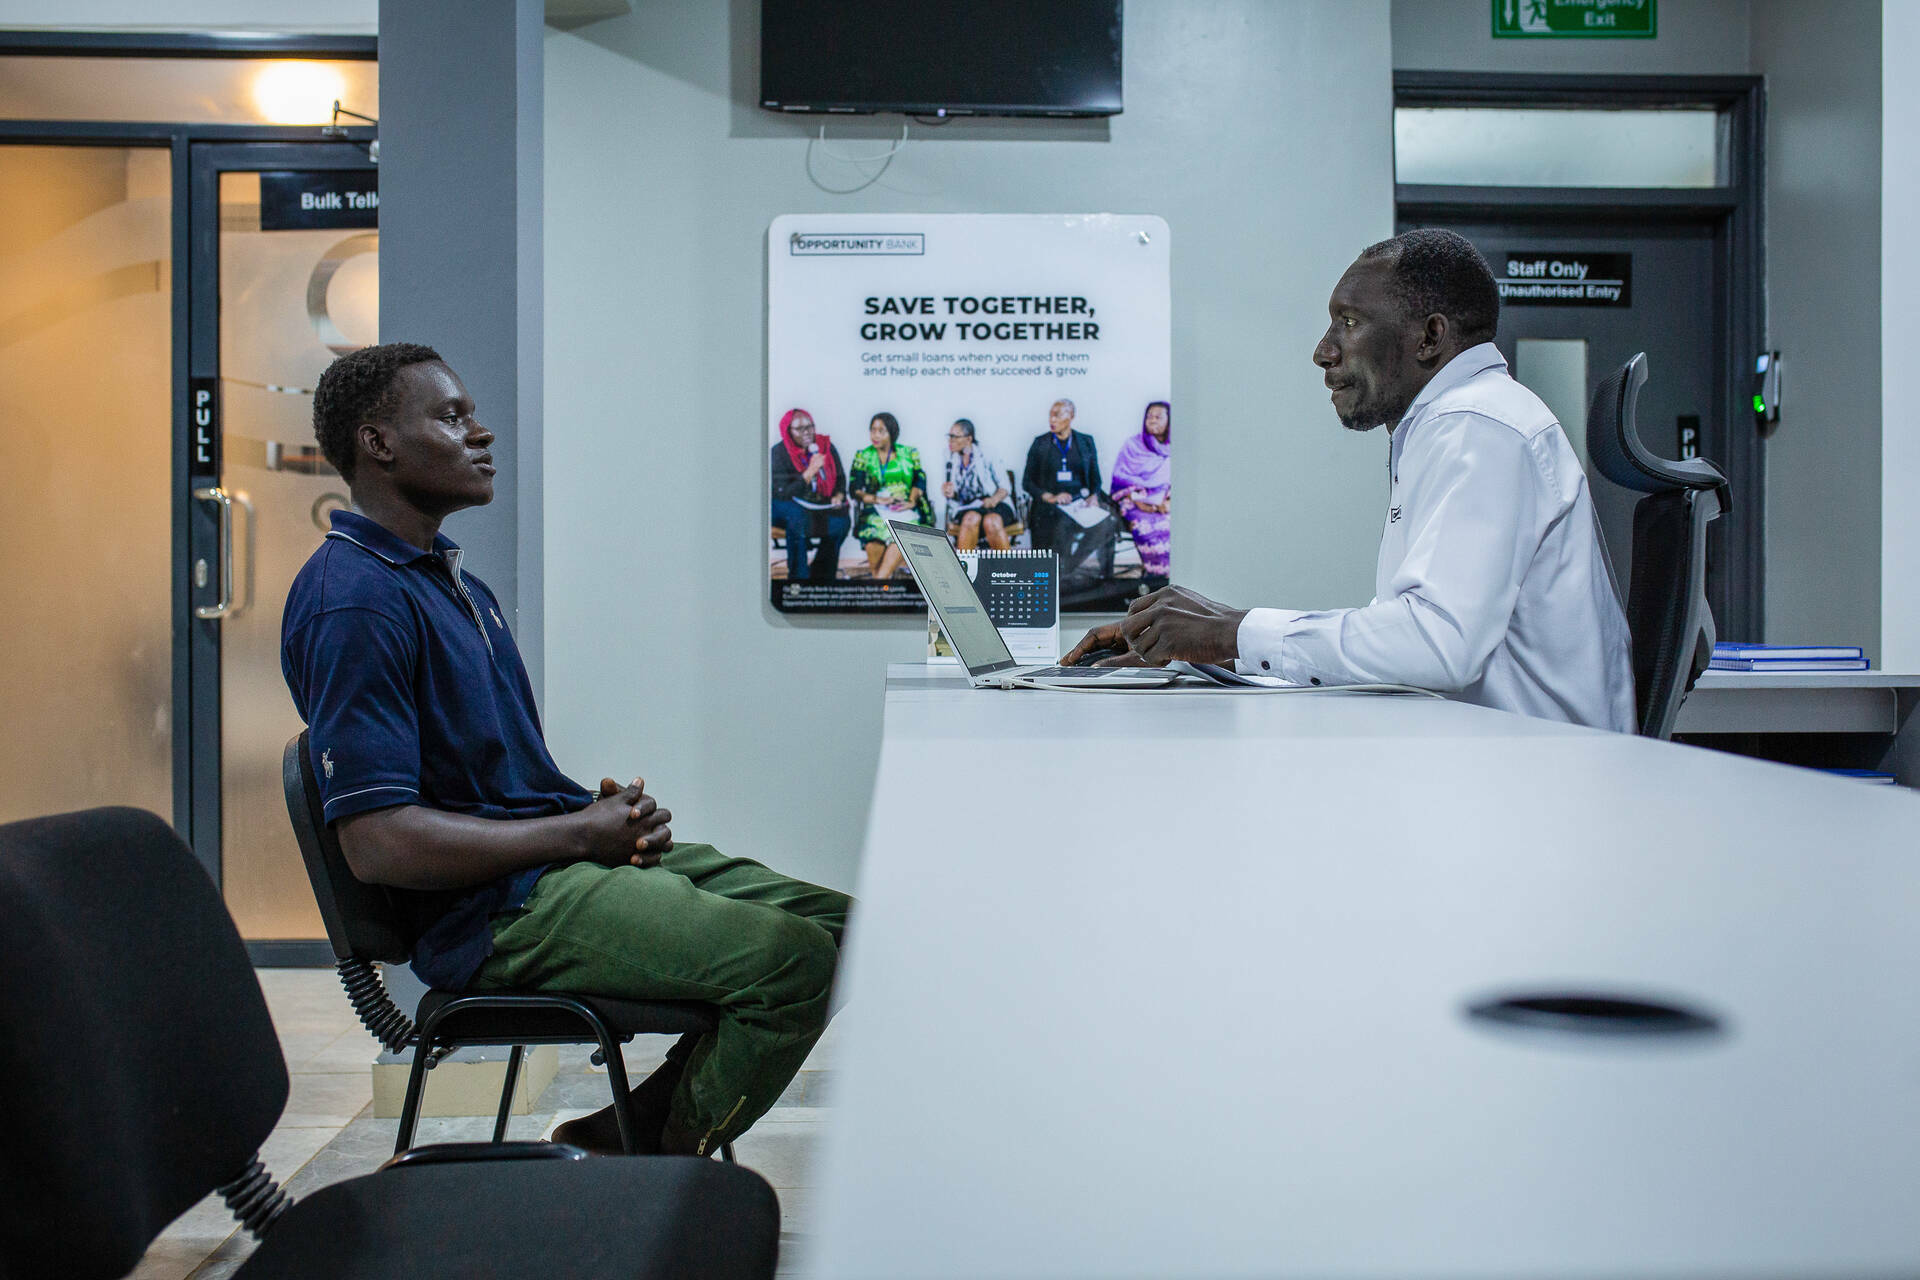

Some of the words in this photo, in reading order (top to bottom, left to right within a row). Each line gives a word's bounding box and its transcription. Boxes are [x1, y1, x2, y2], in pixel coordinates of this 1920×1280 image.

[1584, 11, 1616, 26] Exit
[301, 192, 342, 209] Bulk
[345, 191, 379, 209] Tell
[798, 240, 883, 249] OPPORTUNITY
[886, 240, 917, 249] BANK
[1507, 261, 1547, 277] Staff
[1550, 261, 1588, 280] Only
[1499, 284, 1584, 298] Unauthorised
[1586, 285, 1621, 301] Entry
[864, 297, 935, 315] SAVE
[943, 297, 1095, 318] TOGETHER,
[860, 323, 947, 341] GROW
[955, 323, 1100, 341] TOGETHER
[861, 352, 882, 362] Get
[886, 352, 919, 362] small
[922, 352, 955, 362] loans
[958, 352, 992, 362] when
[995, 354, 1018, 365] you
[1021, 352, 1053, 362] need
[1056, 352, 1090, 362] them
[863, 366, 887, 376] and
[890, 366, 918, 378] help
[921, 366, 950, 376] each
[953, 366, 987, 376] other
[990, 366, 1041, 376] succeed
[1044, 366, 1053, 376] &
[1055, 367, 1088, 378] grow
[196, 389, 211, 462] PULL
[1683, 428, 1696, 460] PU
